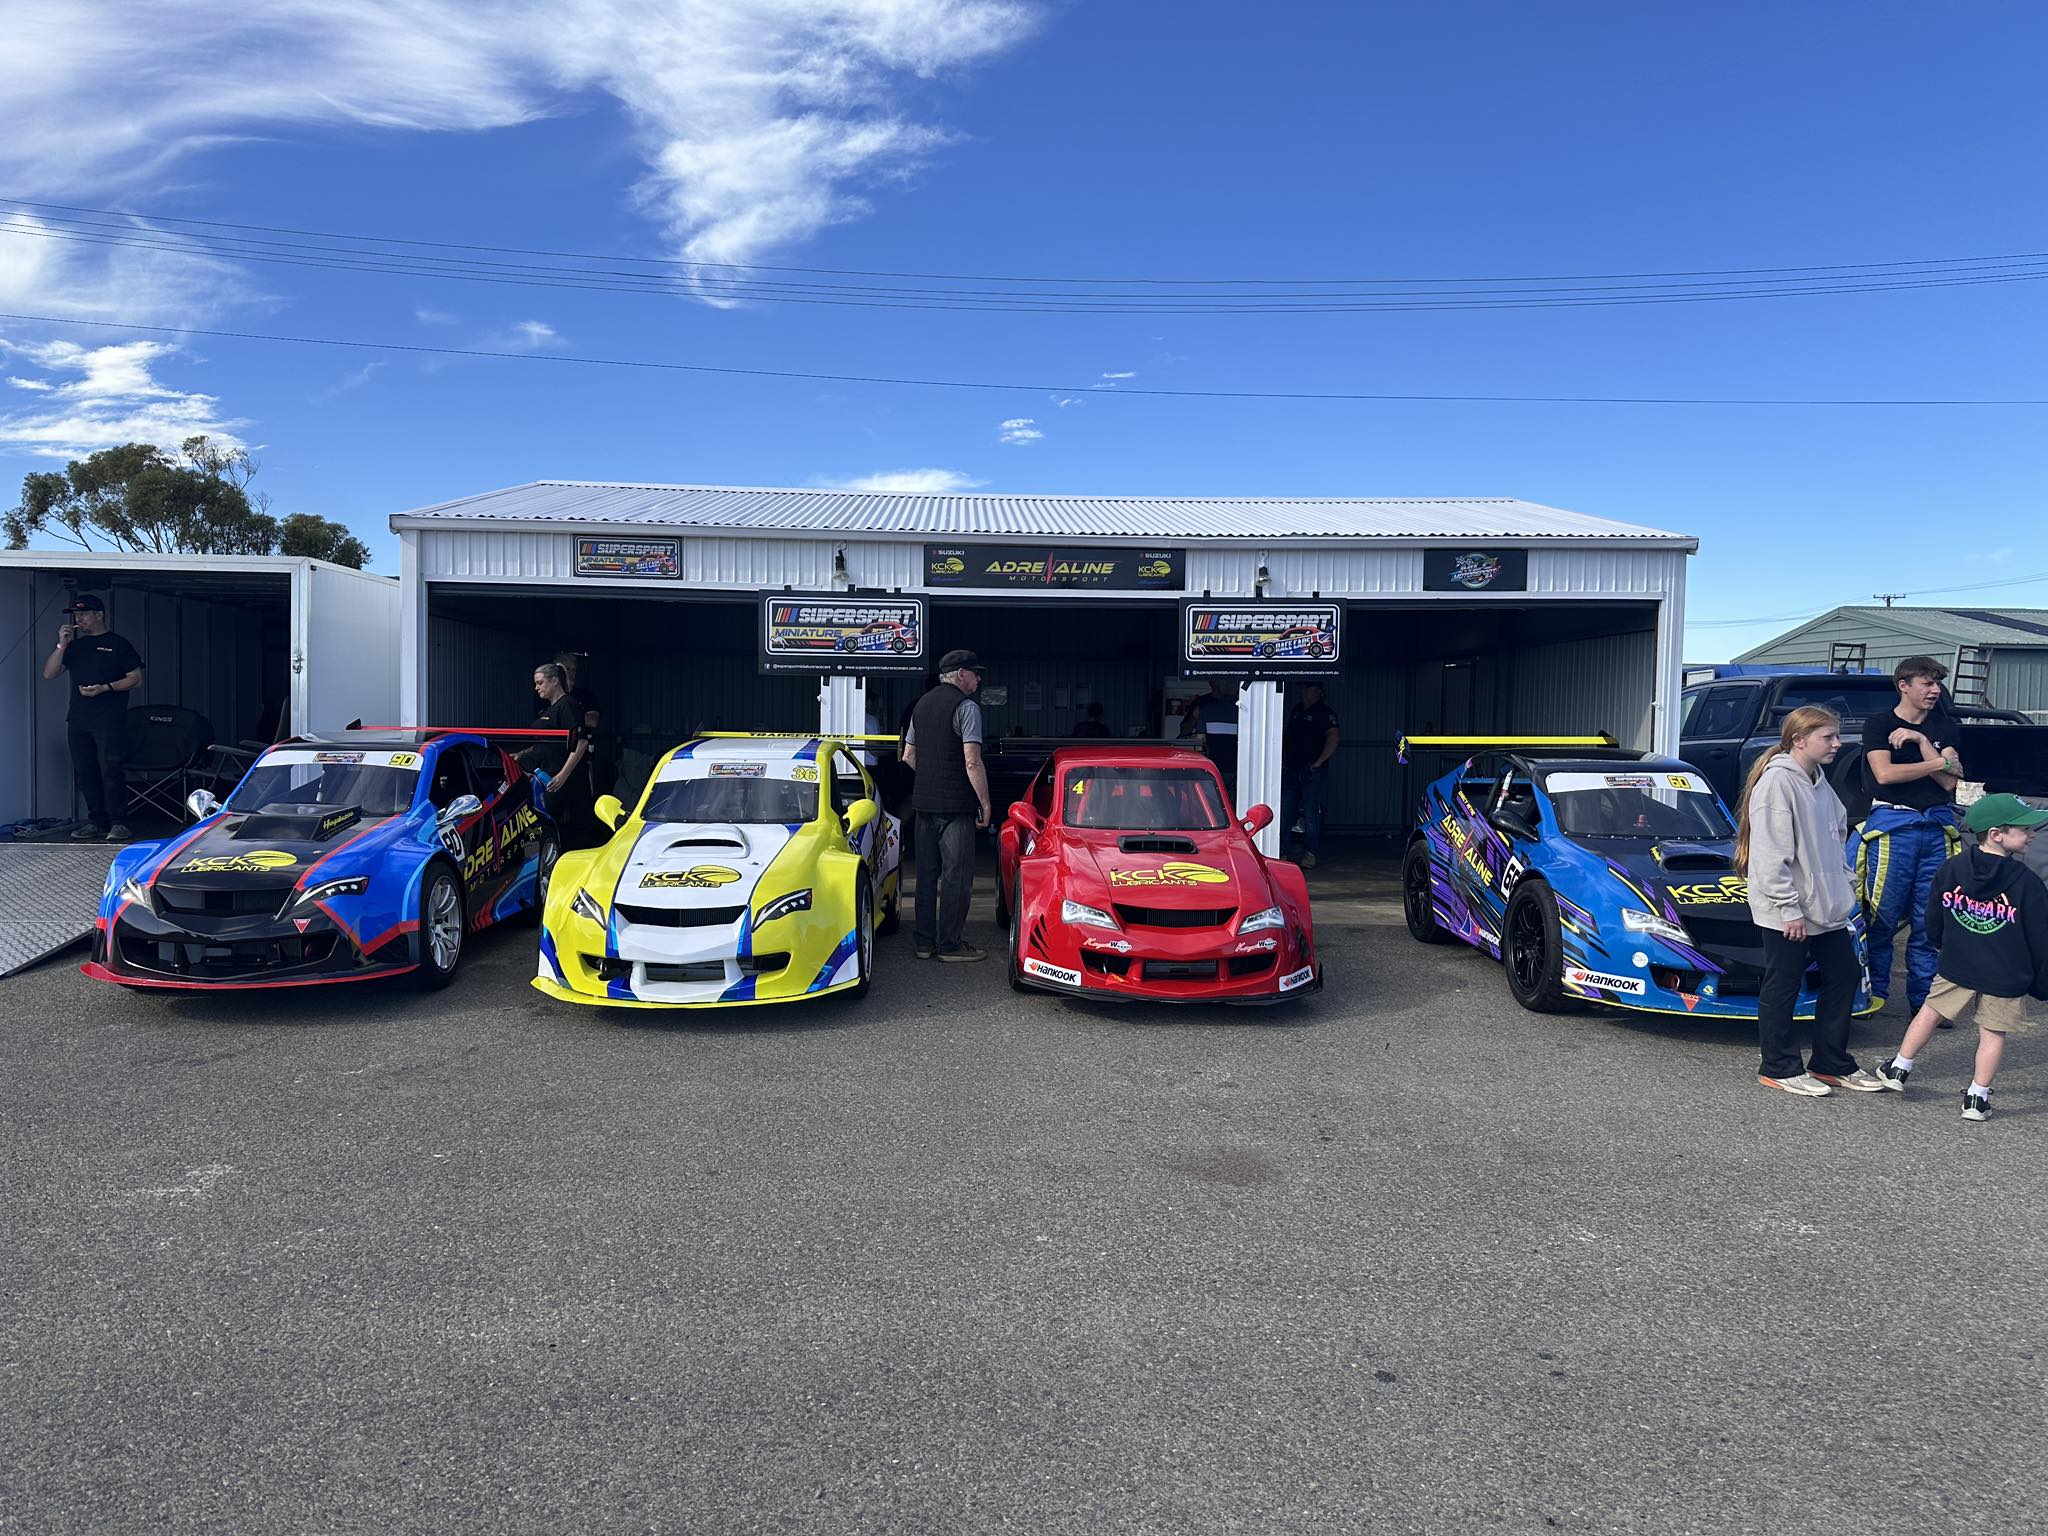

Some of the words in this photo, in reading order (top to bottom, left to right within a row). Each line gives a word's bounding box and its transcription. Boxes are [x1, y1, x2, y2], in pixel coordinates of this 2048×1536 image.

[597, 543, 674, 555] SUPERSPORT
[931, 563, 951, 571] KCK
[1138, 565, 1158, 574] KCK
[798, 607, 914, 625] SUPERSPORT
[1217, 614, 1332, 631] SUPERSPORT
[775, 628, 843, 638] MINIATURE
[857, 634, 875, 648] RACE
[876, 632, 894, 645] CARS
[1194, 635, 1261, 644] MINIATURE
[1275, 639, 1293, 652] RACE
[1293, 637, 1311, 650] CARS
[389, 753, 416, 767] 90
[792, 767, 818, 781] 36
[1072, 780, 1085, 794] 4
[1667, 775, 1692, 789] 60
[185, 856, 252, 866] KCK
[180, 865, 272, 873] LUBRICANTS
[1109, 869, 1182, 881] KCK
[643, 872, 700, 881] KCK
[640, 880, 721, 888] LUBRICANTS
[1666, 884, 1748, 898] KCK
[1676, 896, 1749, 905] LUBRICAN
